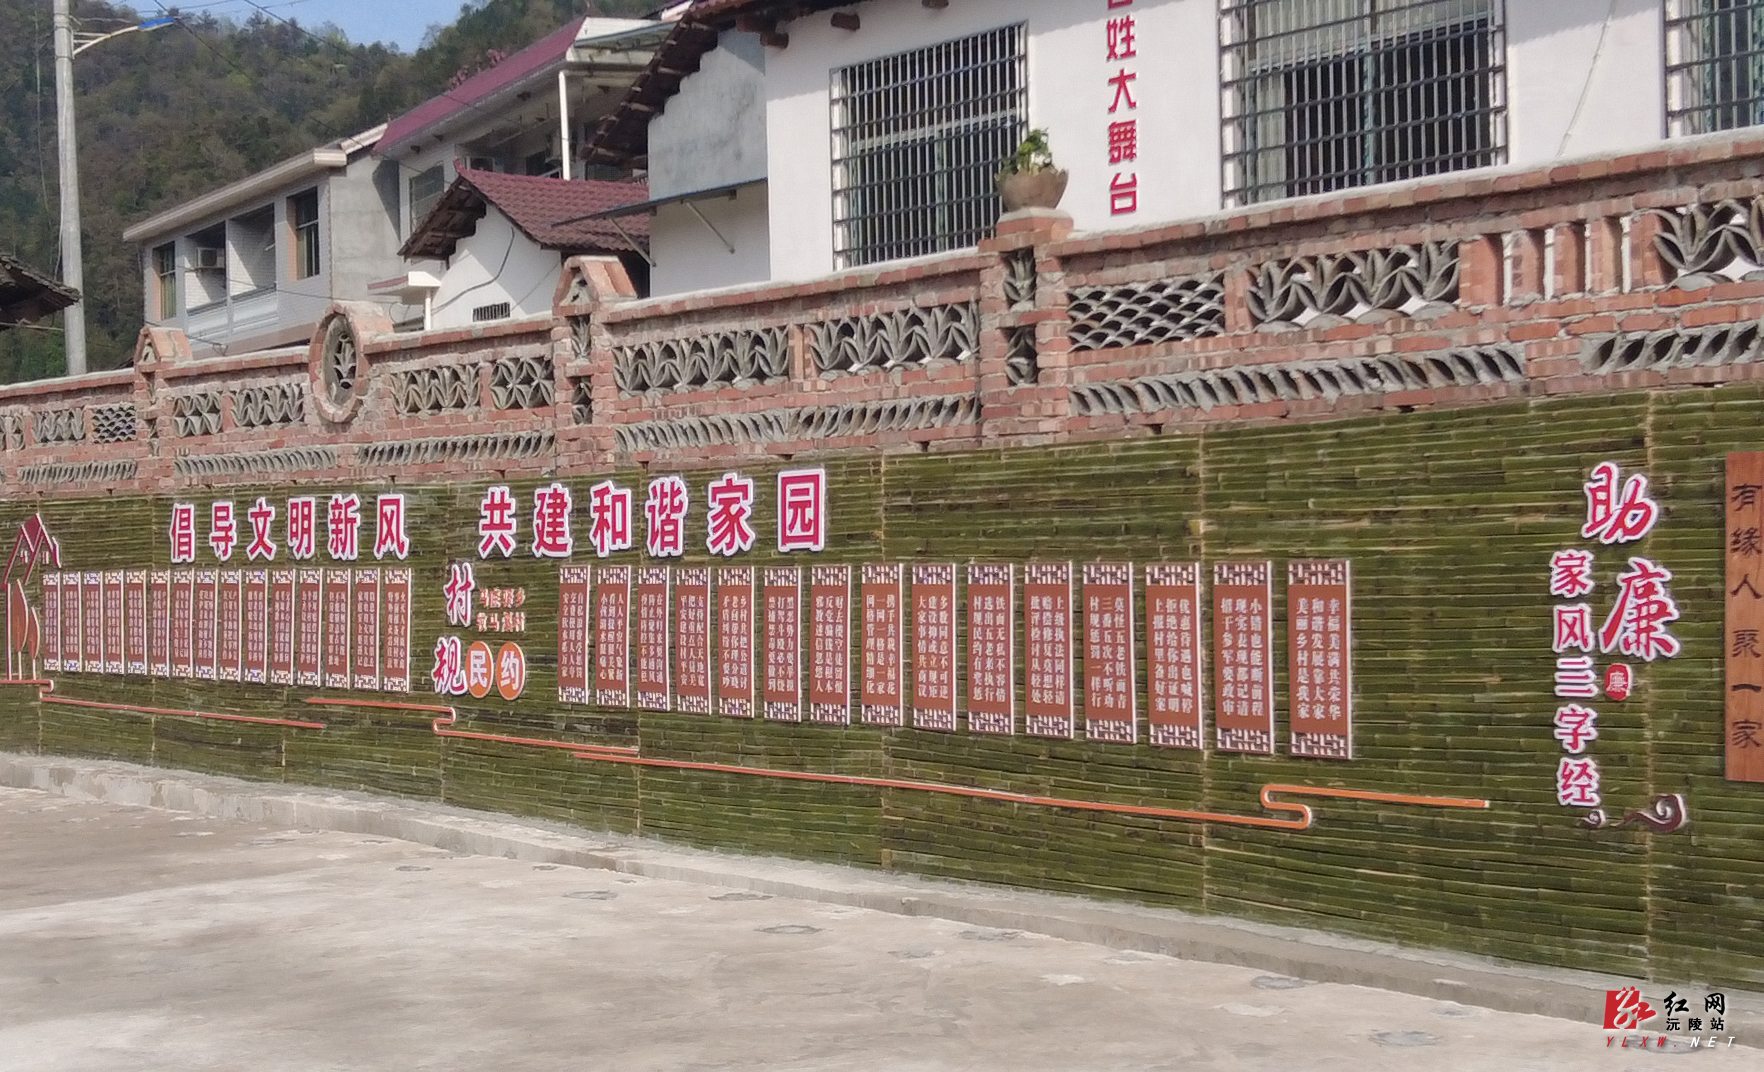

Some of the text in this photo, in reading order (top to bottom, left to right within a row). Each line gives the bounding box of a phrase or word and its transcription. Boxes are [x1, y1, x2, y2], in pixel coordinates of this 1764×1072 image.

[1106, 0, 1138, 216] 姓大舞台
[169, 468, 826, 563] 倡导文明新风 共建和谐家园
[1582, 461, 1681, 662] 助廉
[876, 597, 885, 694] 一网一格是一家
[917, 596, 926, 698] 大家事情共商议
[972, 596, 983, 700] 村规民约有奖惩
[984, 596, 994, 702] 选出五老来执行
[995, 596, 1006, 703] 铁面无私不容情
[1031, 596, 1041, 703] 批评检讨从轻处
[1090, 596, 1101, 708] 村规惩罚一样行
[1102, 597, 1114, 709] 三番五次不听劝
[1114, 597, 1127, 709] 莫怪五老铁面青
[1153, 598, 1166, 712] 上报村里备好案
[1166, 598, 1179, 713] 拒绝给你出证明
[1235, 598, 1249, 716] 现实表现都记清
[1296, 598, 1310, 719] 美丽乡村是我家
[1311, 598, 1326, 720] 和谐发展靠大家
[1327, 598, 1341, 720] 幸福美满共荣华
[1550, 548, 1600, 807] 家风三字经
